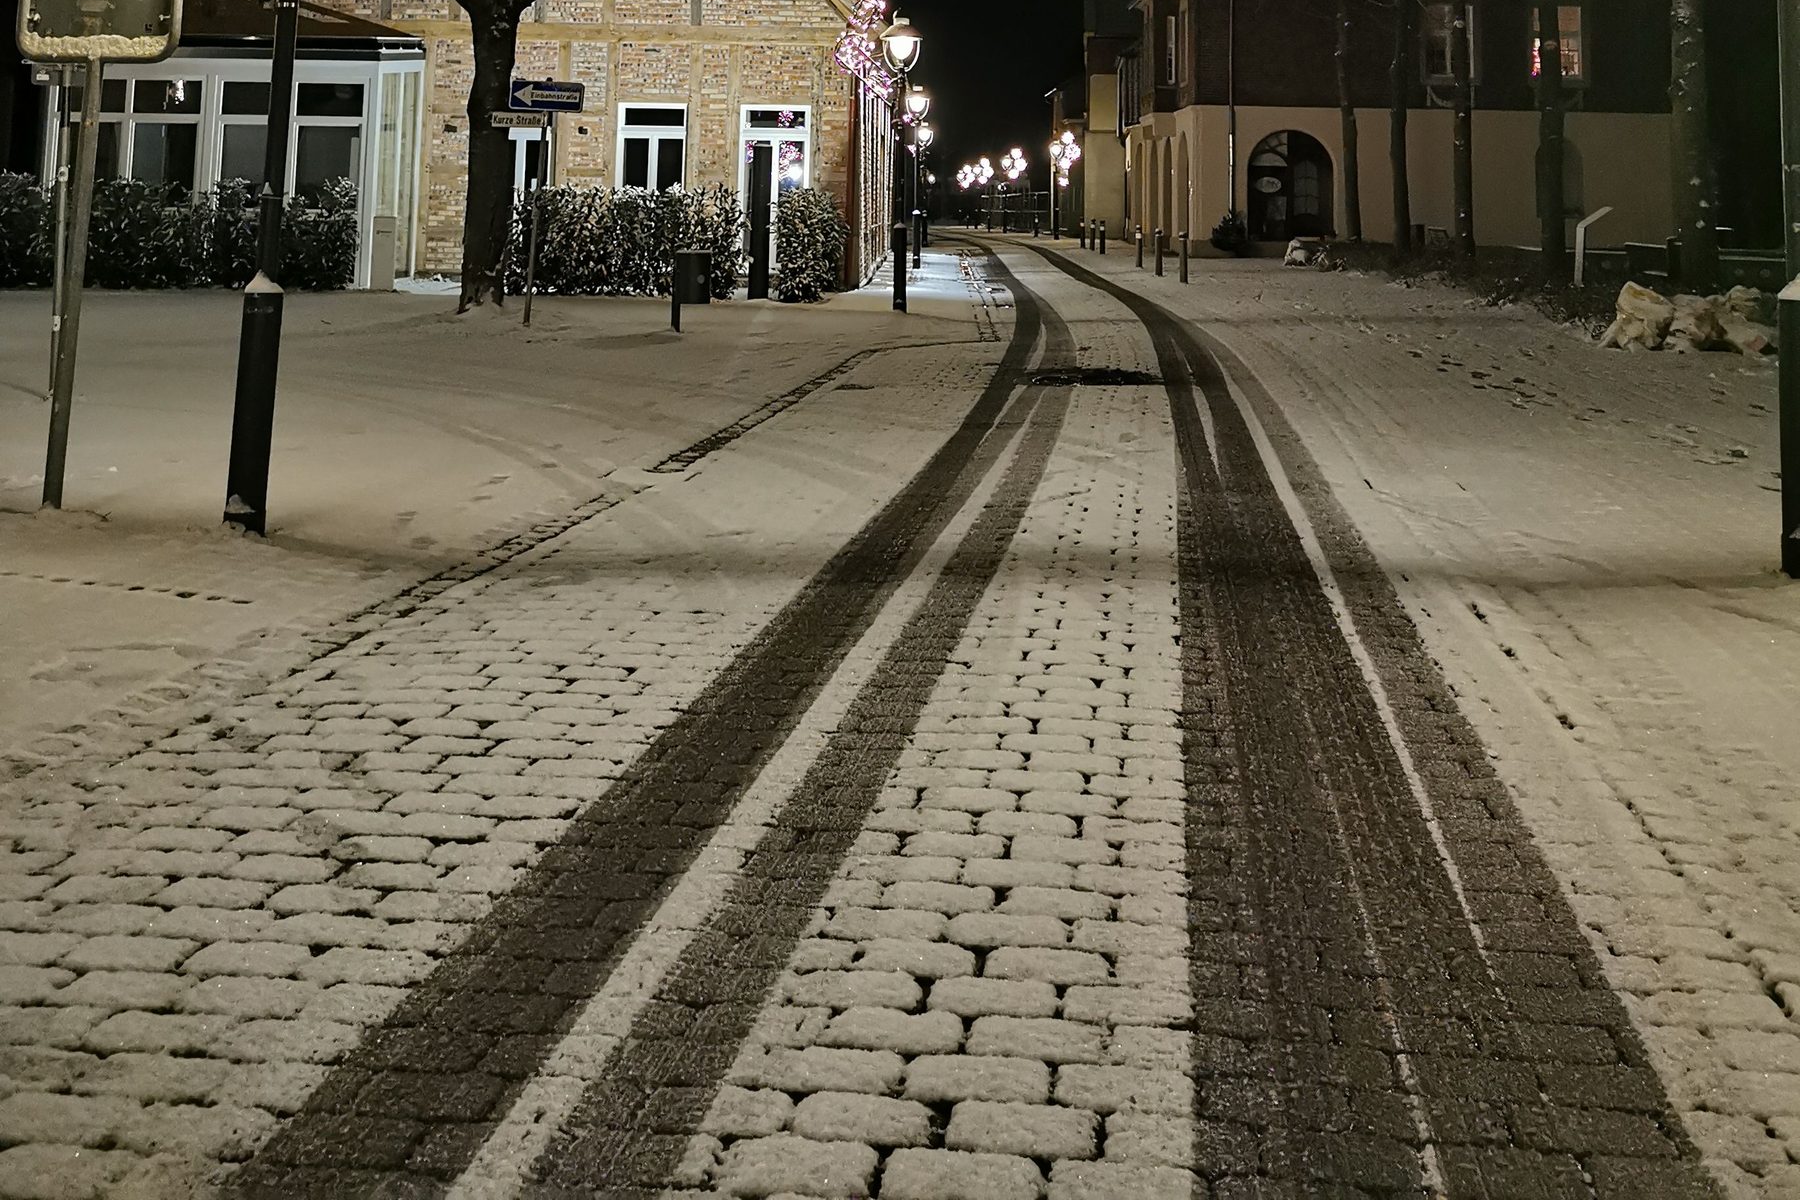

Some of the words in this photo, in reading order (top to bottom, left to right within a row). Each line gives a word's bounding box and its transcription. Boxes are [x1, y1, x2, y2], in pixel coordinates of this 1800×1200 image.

[530, 91, 578, 101] Einbahnstraße
[493, 114, 514, 125] Kurze
[516, 114, 541, 125] Straße
